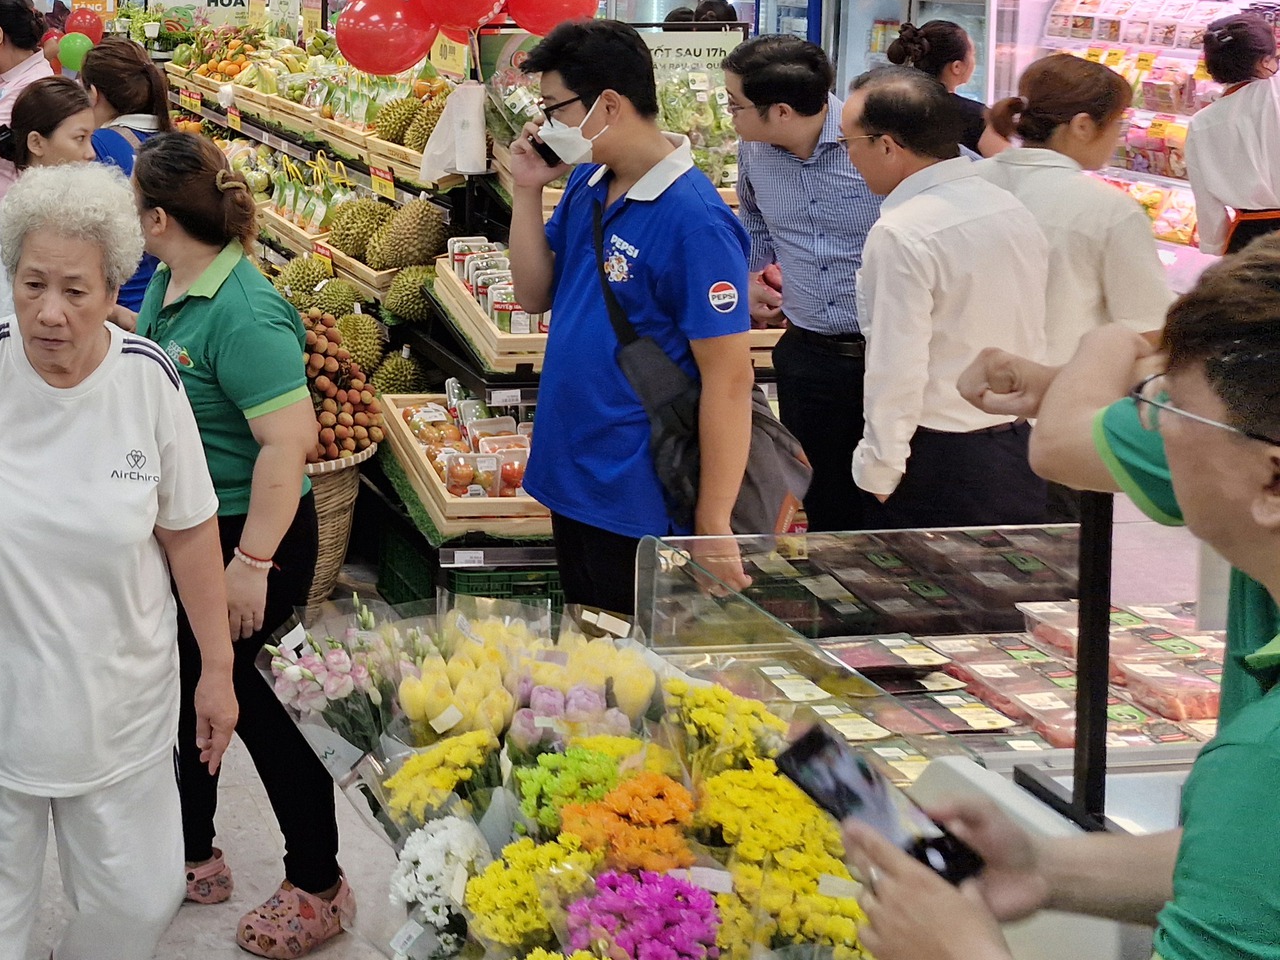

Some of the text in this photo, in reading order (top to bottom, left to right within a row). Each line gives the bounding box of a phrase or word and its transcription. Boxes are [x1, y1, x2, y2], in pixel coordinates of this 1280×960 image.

[676, 48, 702, 58] SAU
[706, 47, 727, 58] 17h
[609, 234, 640, 259] PEPSI
[711, 293, 736, 302] PEPSI
[111, 469, 160, 482] AirChiro
